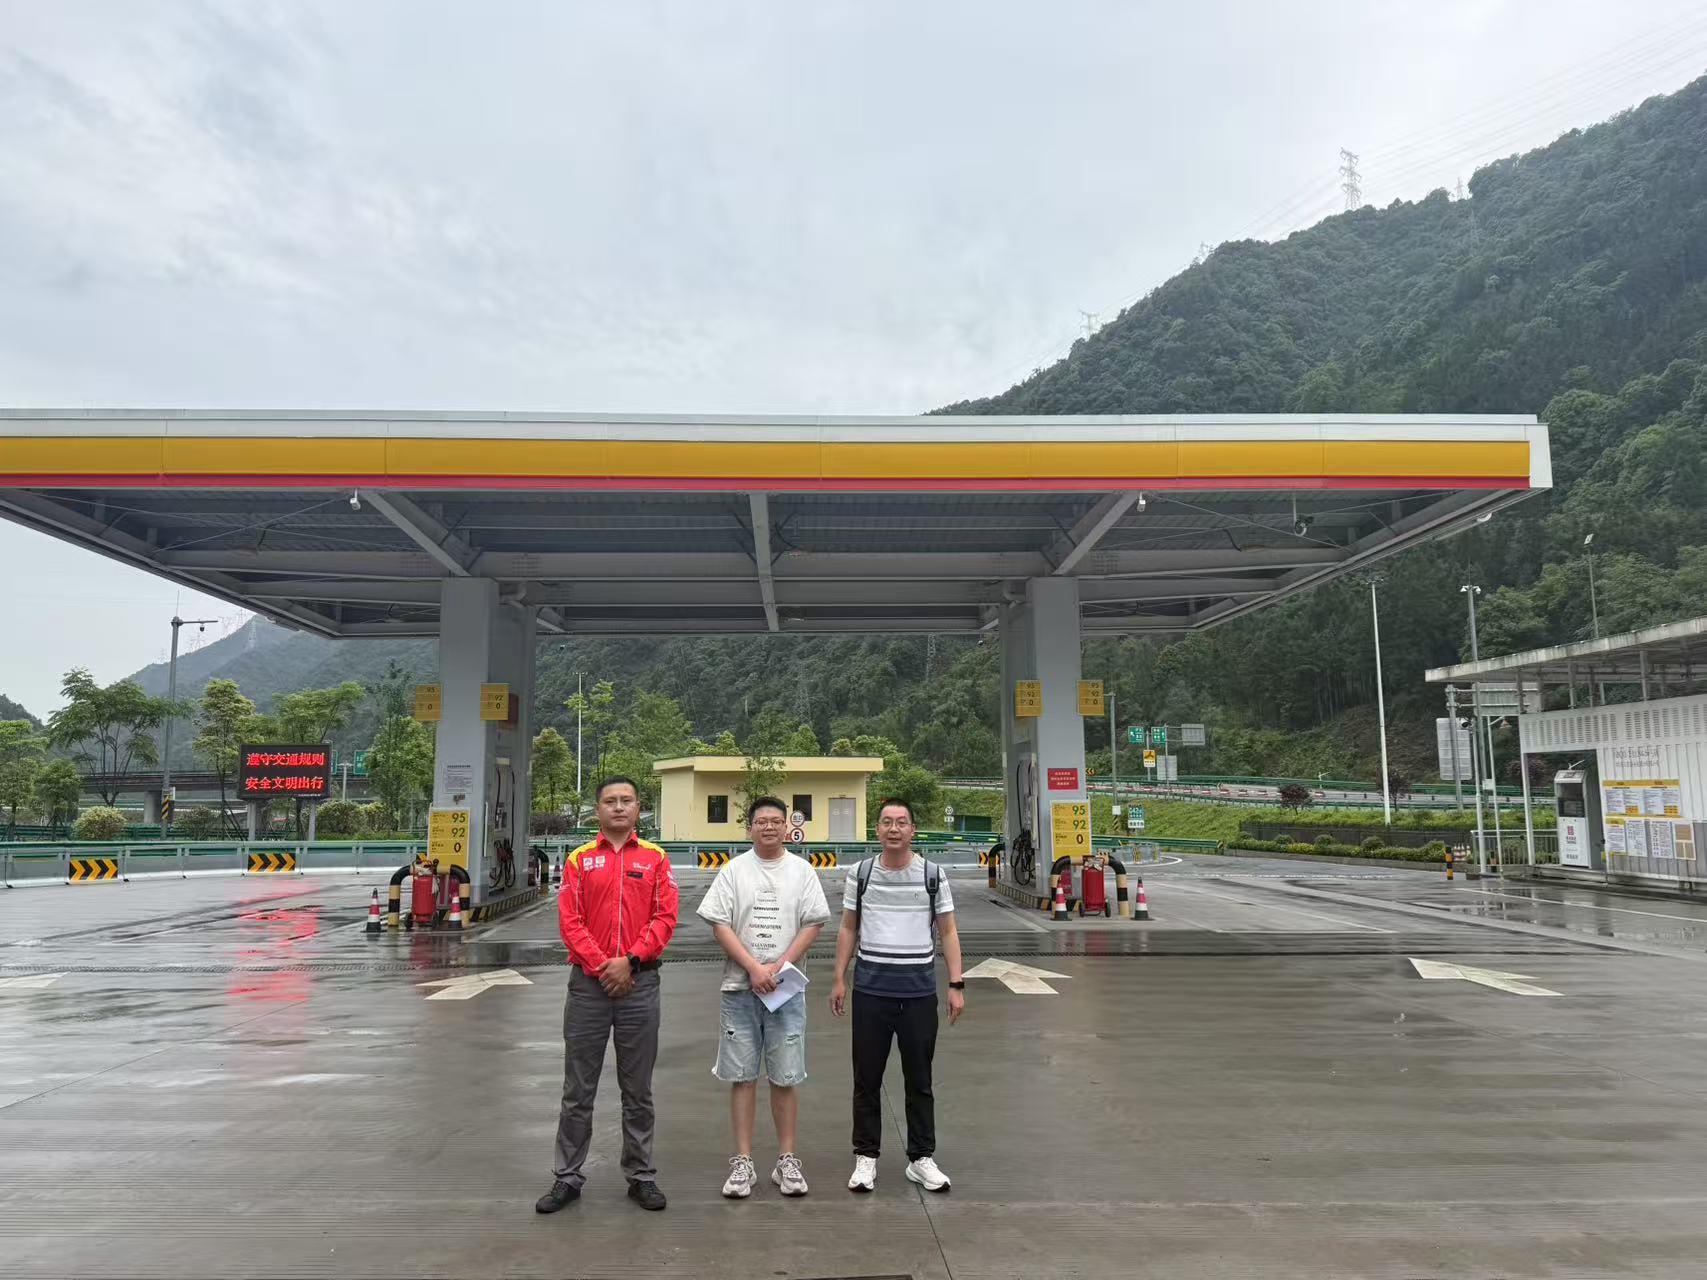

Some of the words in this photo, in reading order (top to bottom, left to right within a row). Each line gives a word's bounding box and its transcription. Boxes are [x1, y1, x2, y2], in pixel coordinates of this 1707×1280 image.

[246, 752, 325, 766] 遵守交通规则
[245, 776, 324, 790] 安全文明出行
[1072, 805, 1086, 815] 95
[452, 812, 466, 823] 95
[1072, 820, 1086, 830] 92
[452, 827, 465, 838] 92
[794, 831, 800, 841] 5
[1076, 834, 1084, 844] 0
[454, 842, 462, 853] 0
